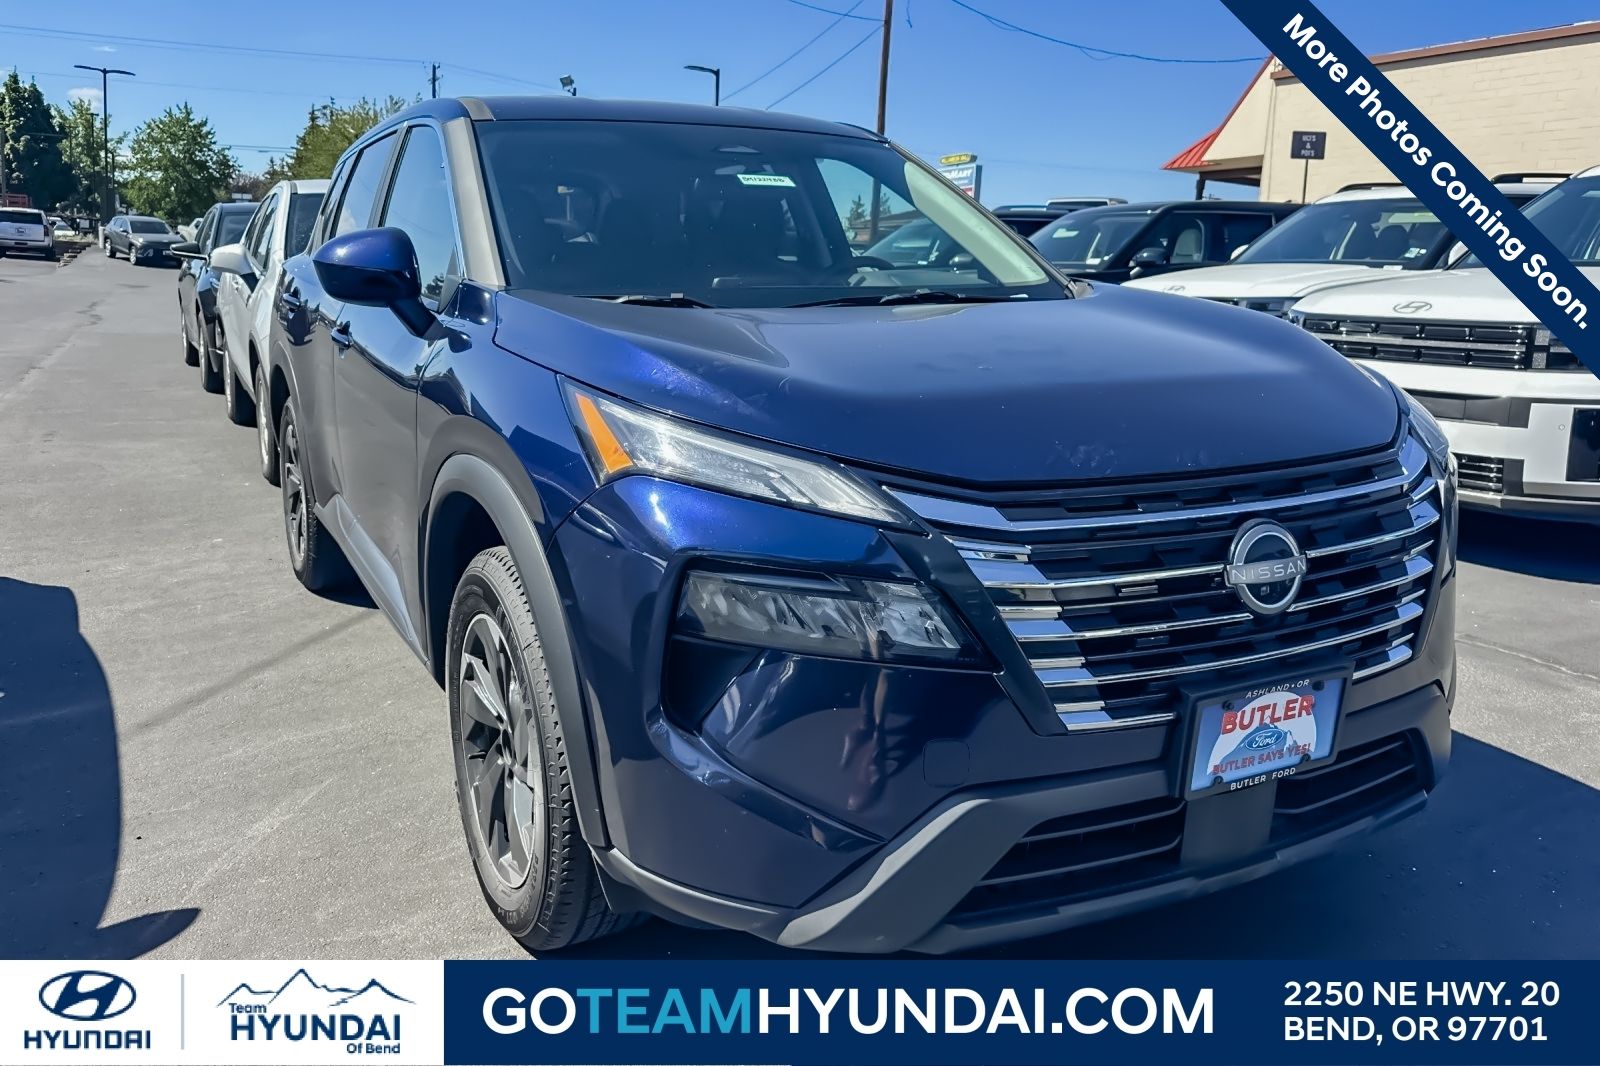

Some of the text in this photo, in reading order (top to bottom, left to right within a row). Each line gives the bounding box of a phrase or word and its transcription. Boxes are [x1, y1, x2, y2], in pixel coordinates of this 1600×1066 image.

[1231, 558, 1306, 581] NISSAN
[1246, 679, 1310, 699] ASHLAND OR
[1221, 694, 1315, 735] BUTLER
[1252, 732, 1278, 748] Ford
[1212, 743, 1312, 775] BUTLER SAYS YES!
[1230, 767, 1296, 790] BUTLER FORD
